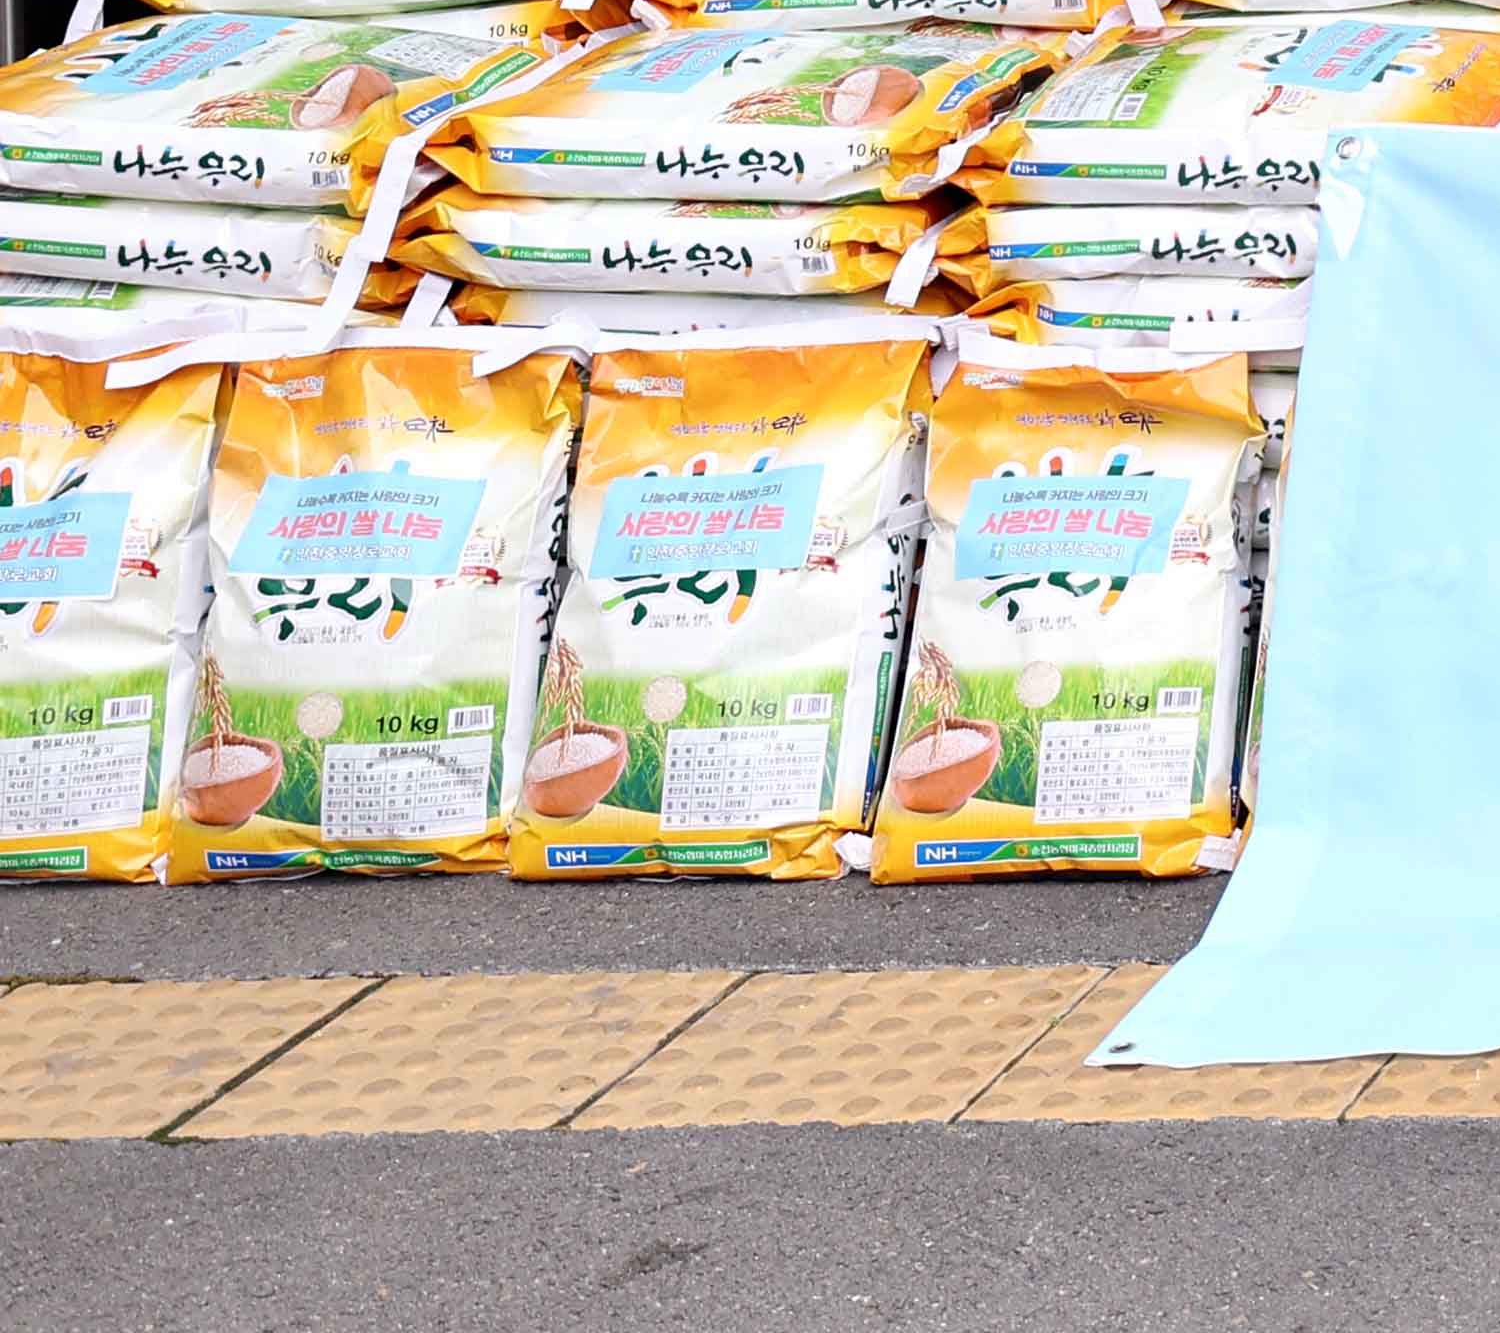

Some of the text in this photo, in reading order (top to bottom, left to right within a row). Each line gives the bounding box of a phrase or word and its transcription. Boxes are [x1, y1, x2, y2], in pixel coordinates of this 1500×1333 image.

[267, 509, 443, 540] 사랑의 쌀 나눔
[978, 508, 1152, 538] 사랑의 쌀 나눔
[1092, 692, 1150, 712] 10 kg
[375, 714, 438, 734] 10 kg
[215, 854, 249, 868] NH
[924, 847, 958, 861] NH
